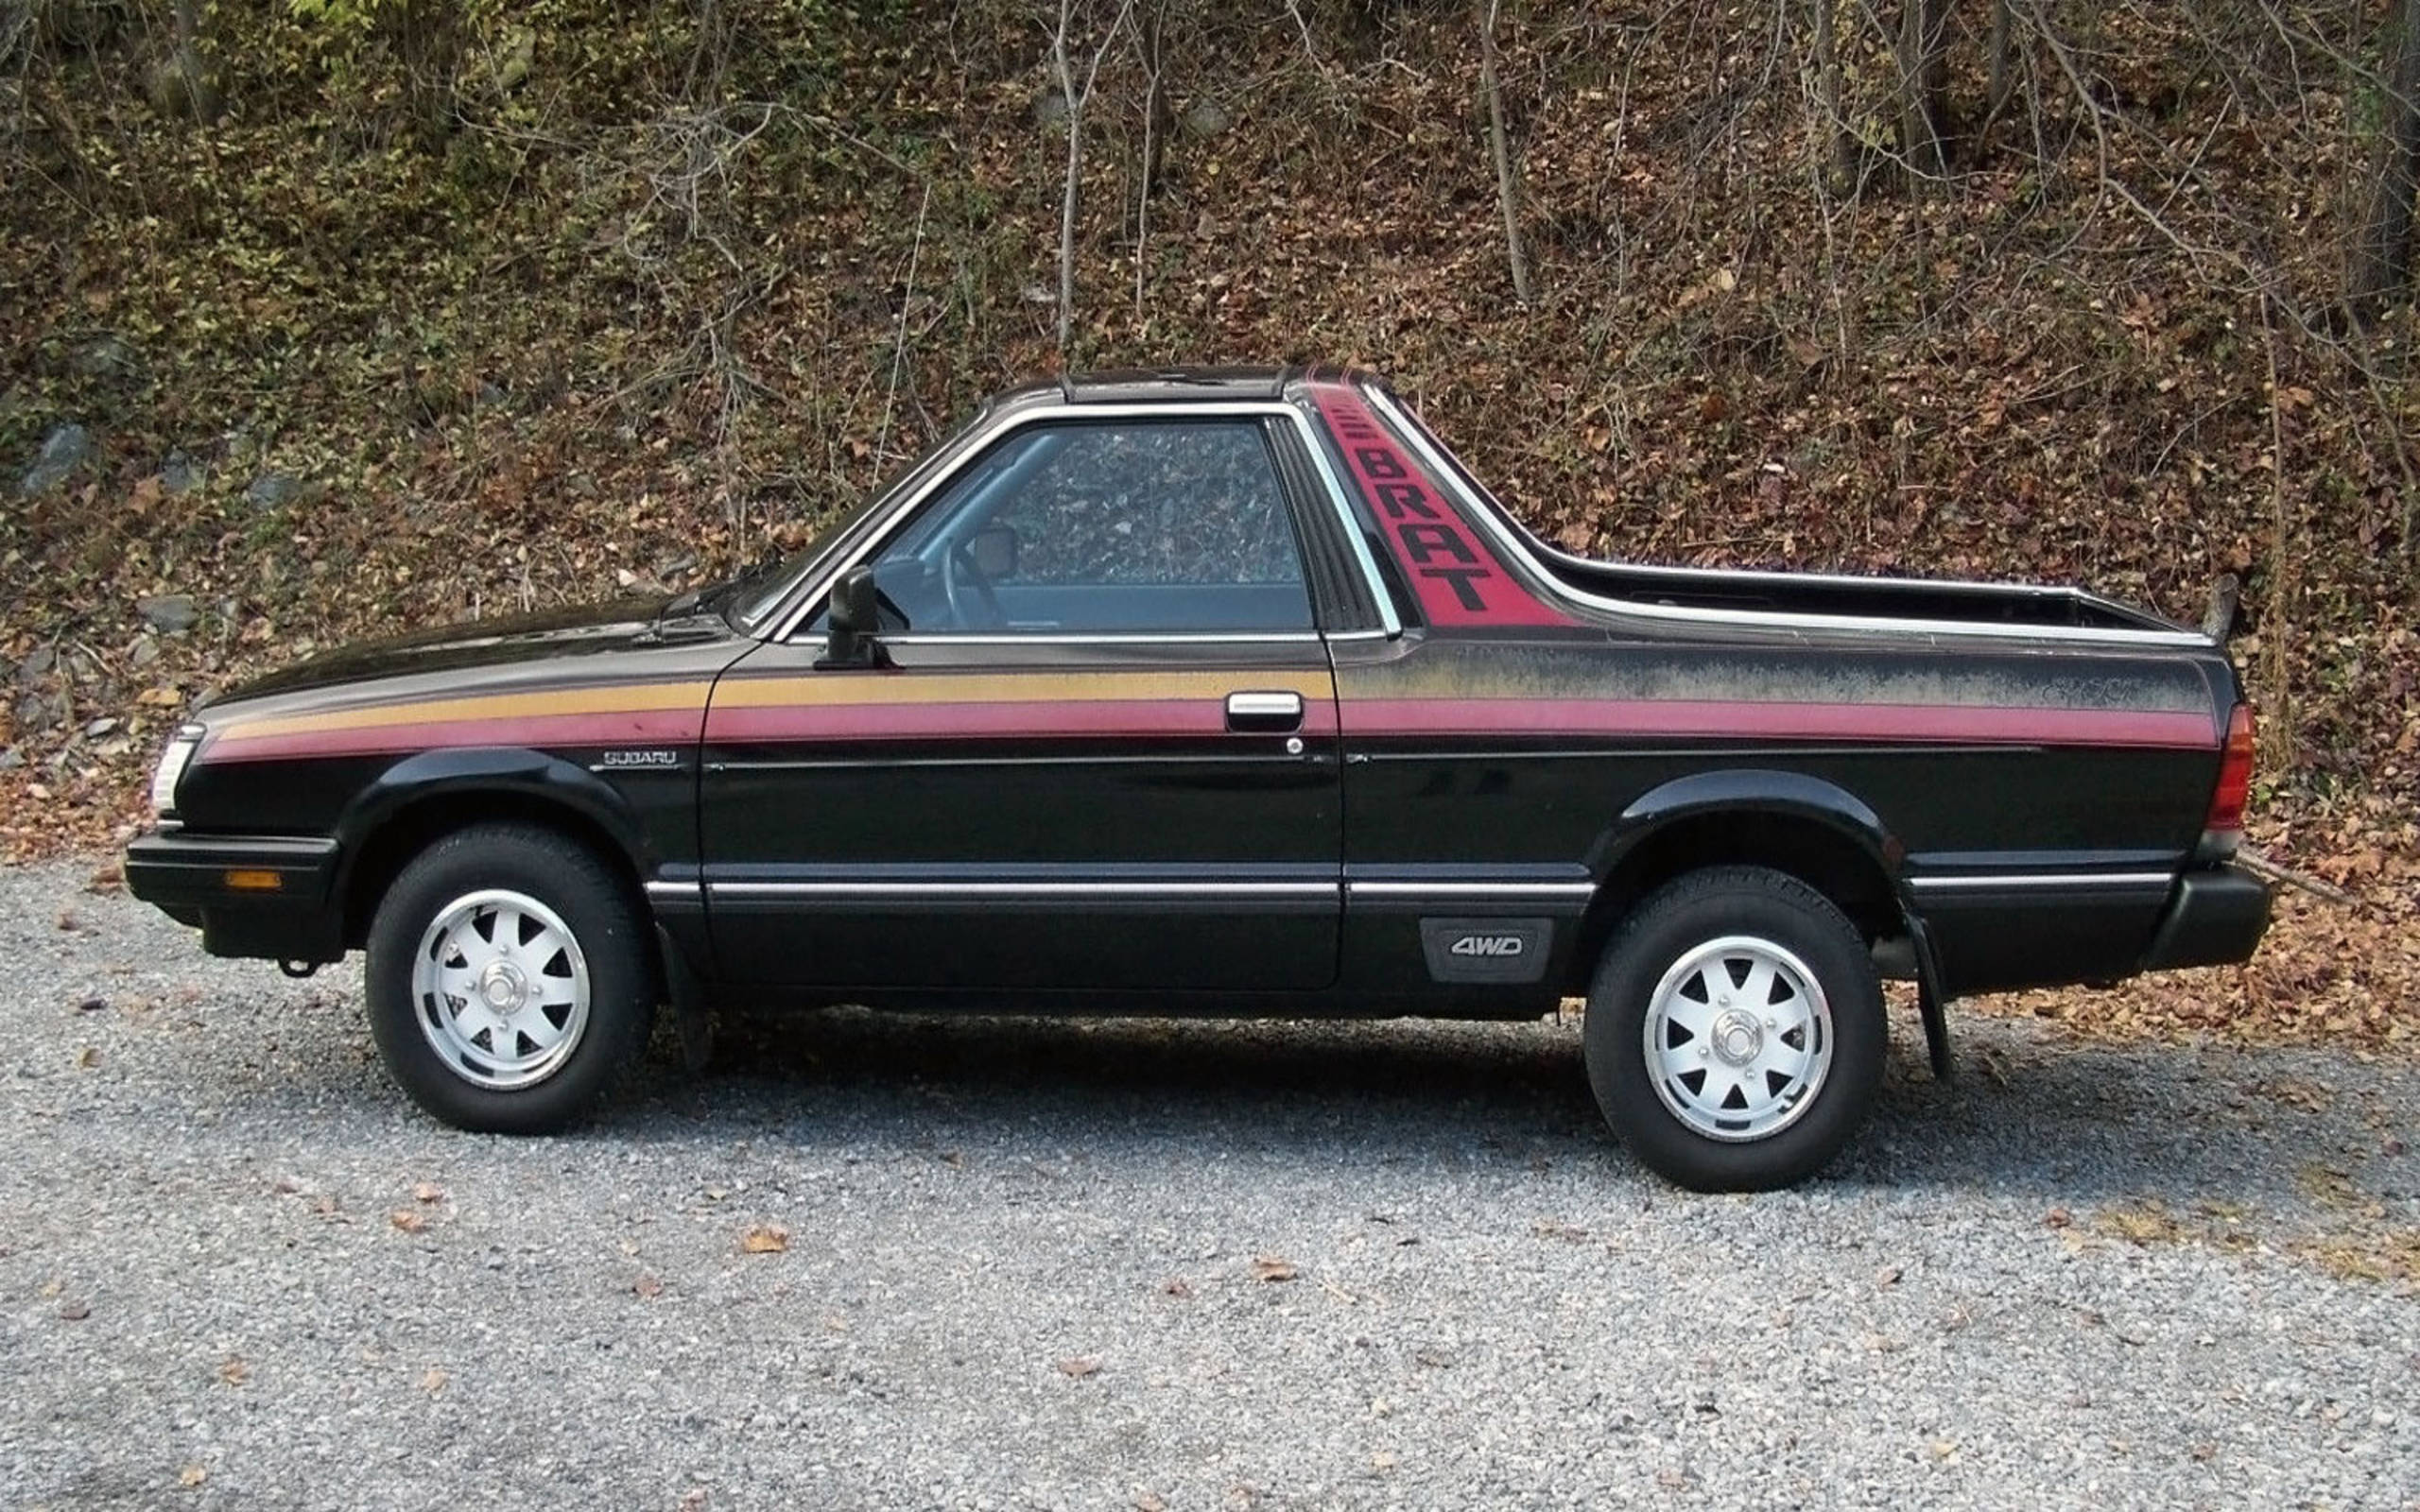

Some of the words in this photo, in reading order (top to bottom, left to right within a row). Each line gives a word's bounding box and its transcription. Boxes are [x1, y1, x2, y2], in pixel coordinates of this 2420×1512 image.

[1355, 447, 1491, 611] BRAT
[603, 751, 677, 765] SUBARU
[1451, 936, 1523, 955] 4WD
